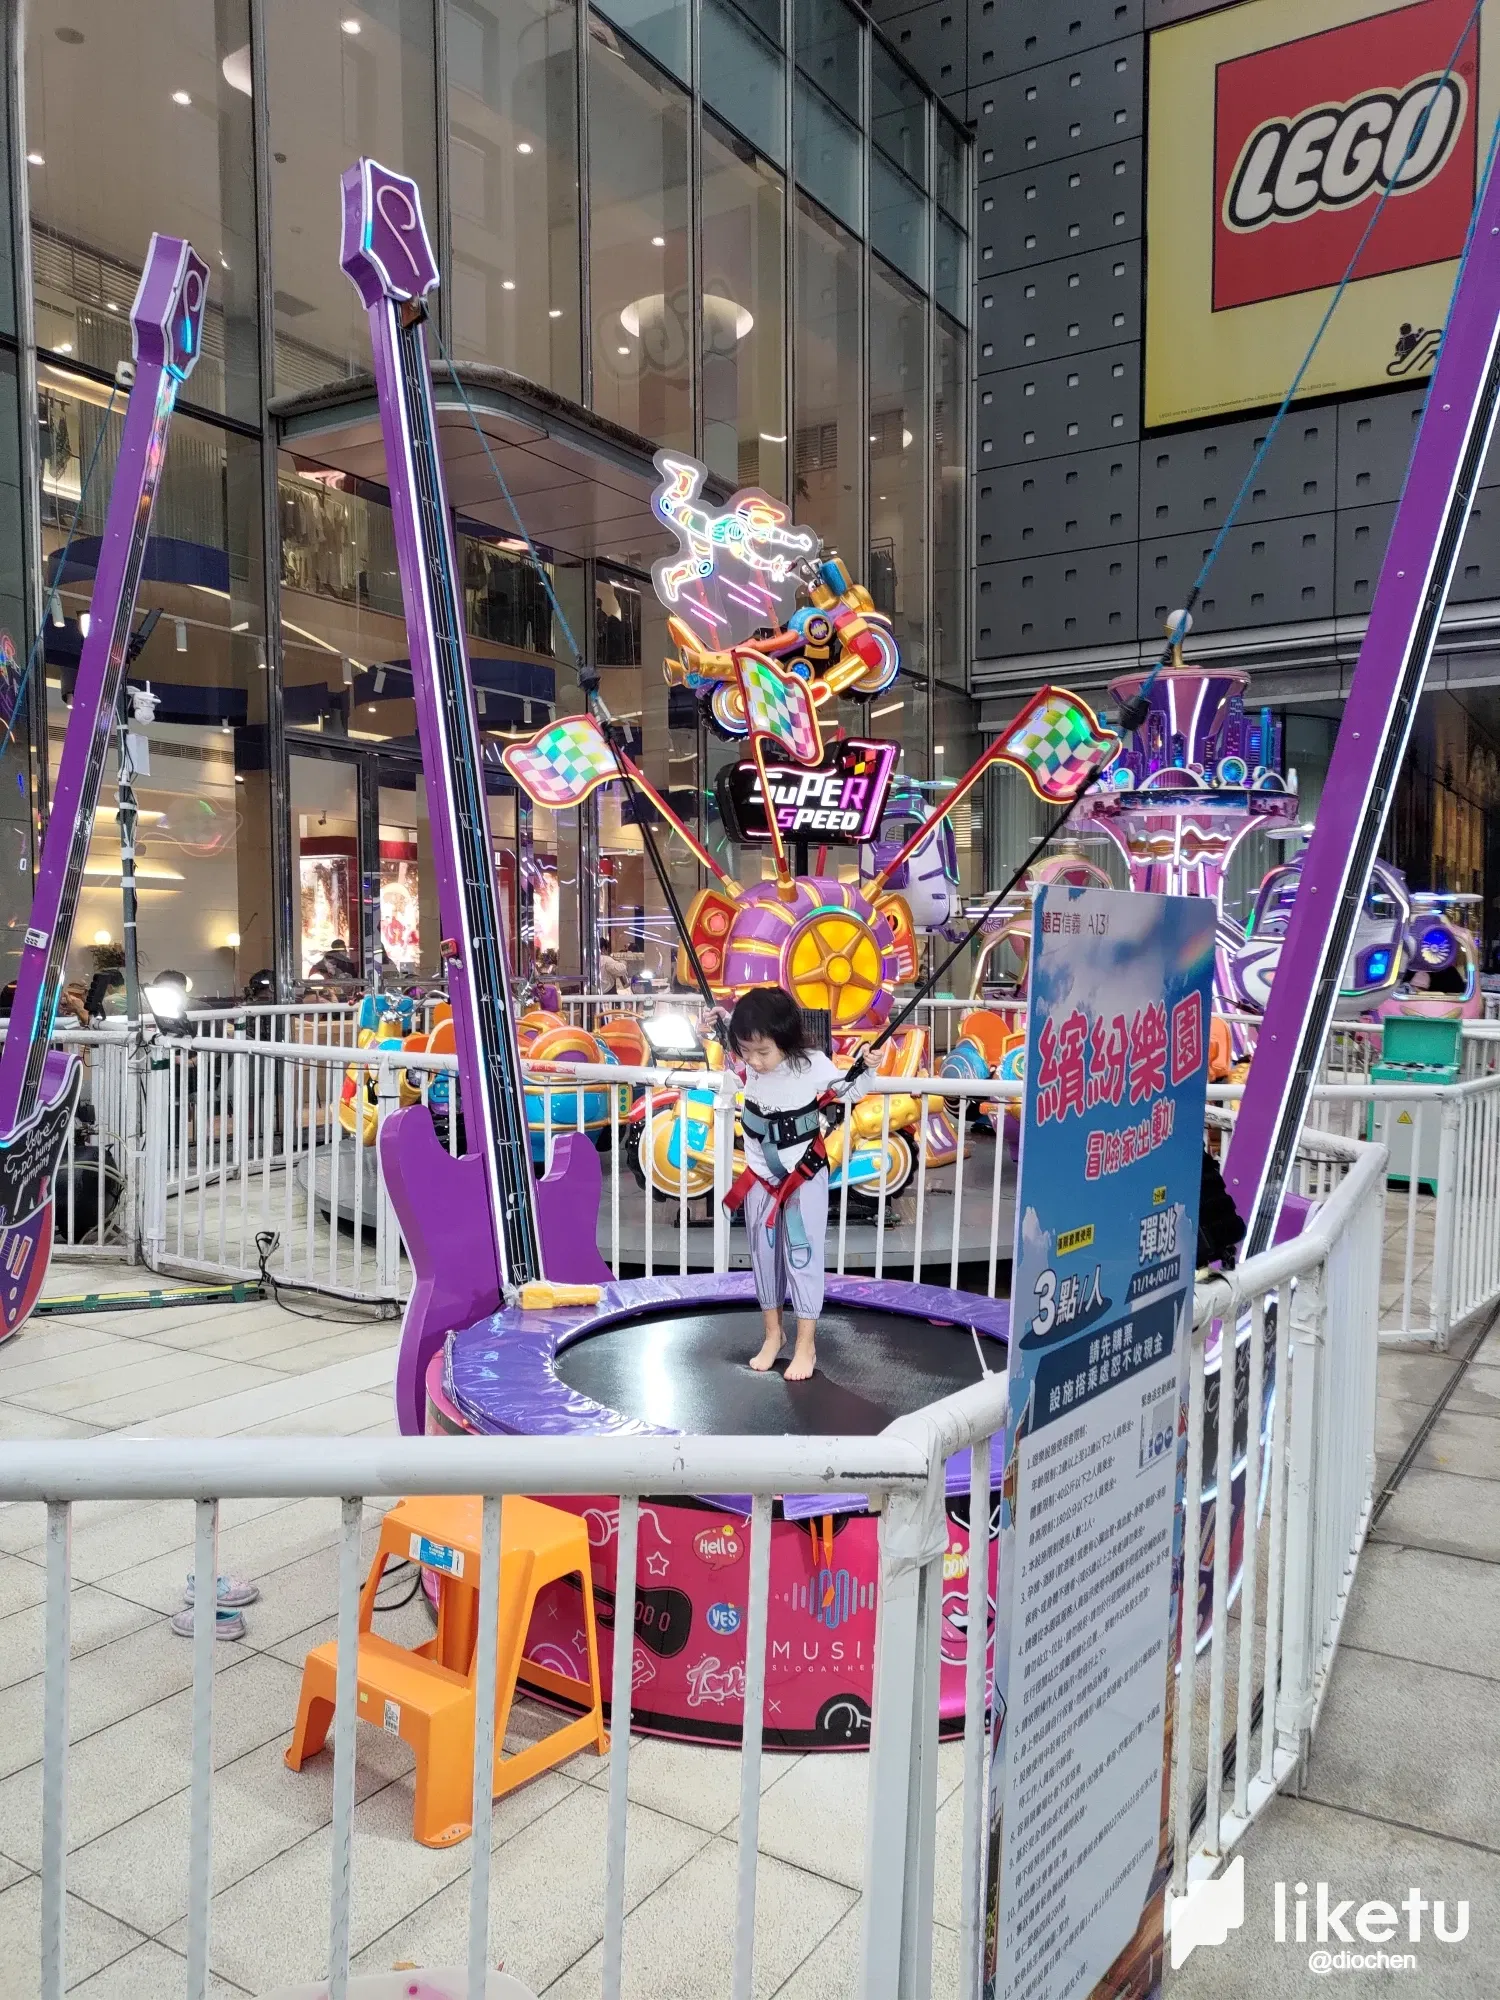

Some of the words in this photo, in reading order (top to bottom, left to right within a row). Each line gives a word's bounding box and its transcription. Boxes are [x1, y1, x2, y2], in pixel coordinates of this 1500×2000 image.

[1228, 77, 1460, 226] LEGO
[777, 807, 861, 831] SPEED
[1036, 989, 1204, 1127] 繽紛樂園
[1138, 1206, 1178, 1266] 彈跳
[698, 1537, 738, 1556] Hello
[712, 1608, 739, 1628] YES
[773, 1641, 877, 1660] MUSI
